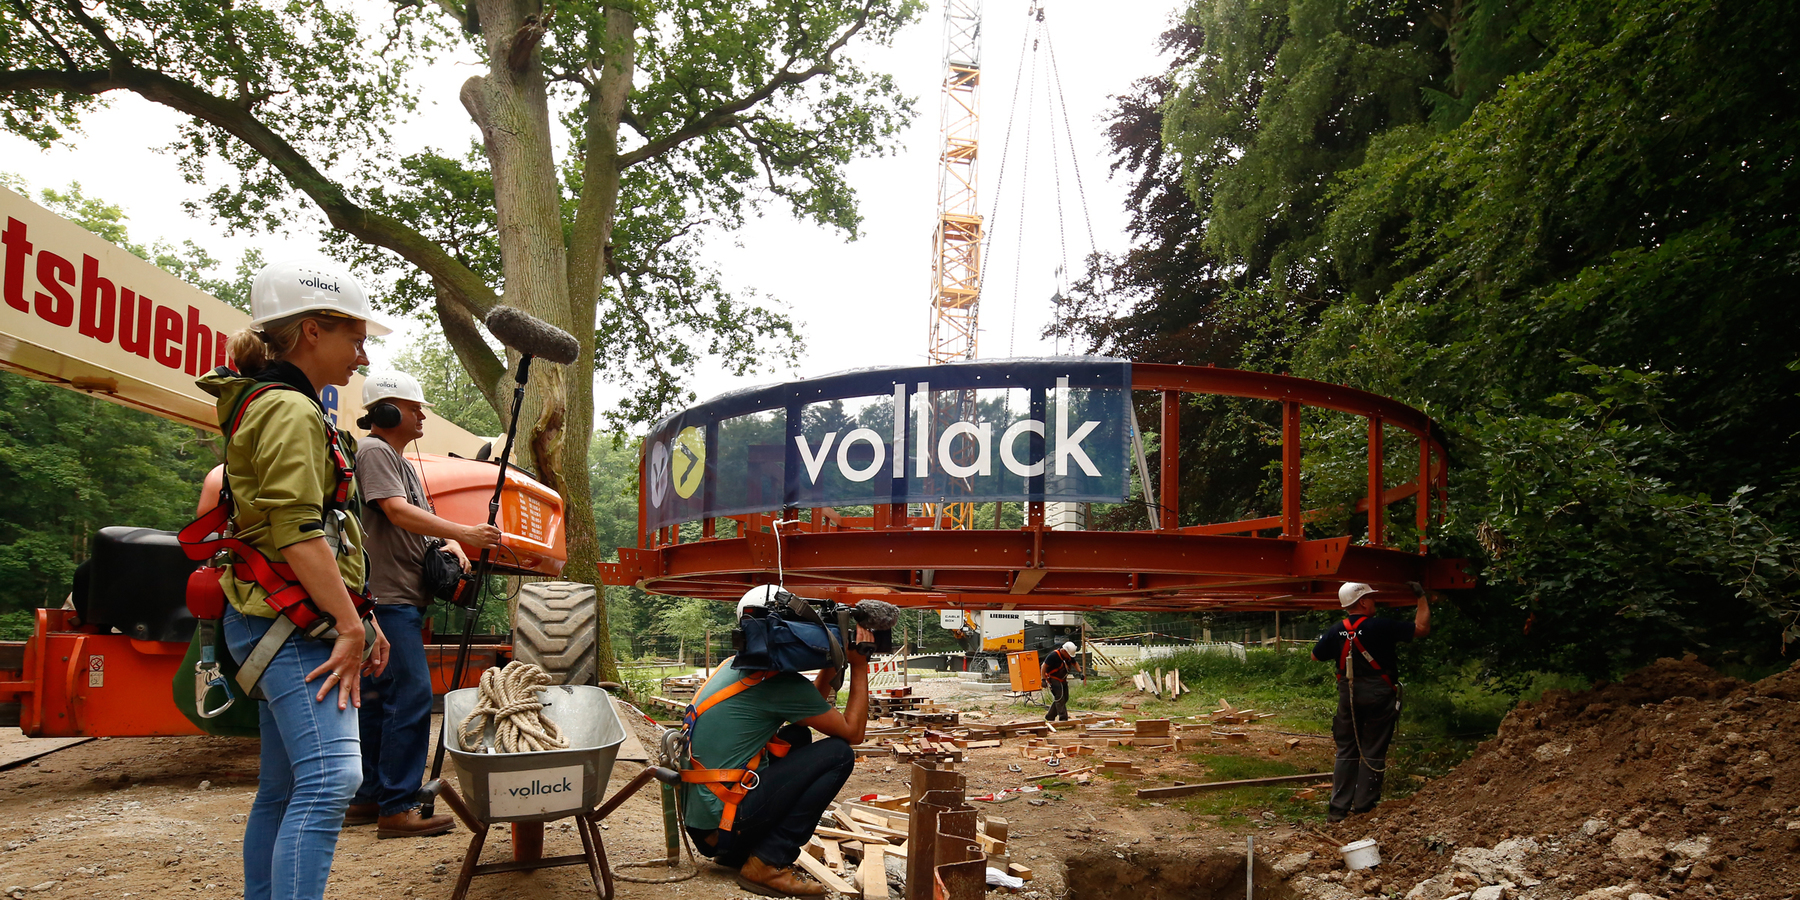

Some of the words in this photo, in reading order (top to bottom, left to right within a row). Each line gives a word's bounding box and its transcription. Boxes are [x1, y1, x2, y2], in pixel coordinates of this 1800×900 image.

[299, 276, 341, 294] vollack
[376, 380, 398, 389] vollack
[795, 377, 1102, 486] vollack
[508, 777, 573, 797] vollack
